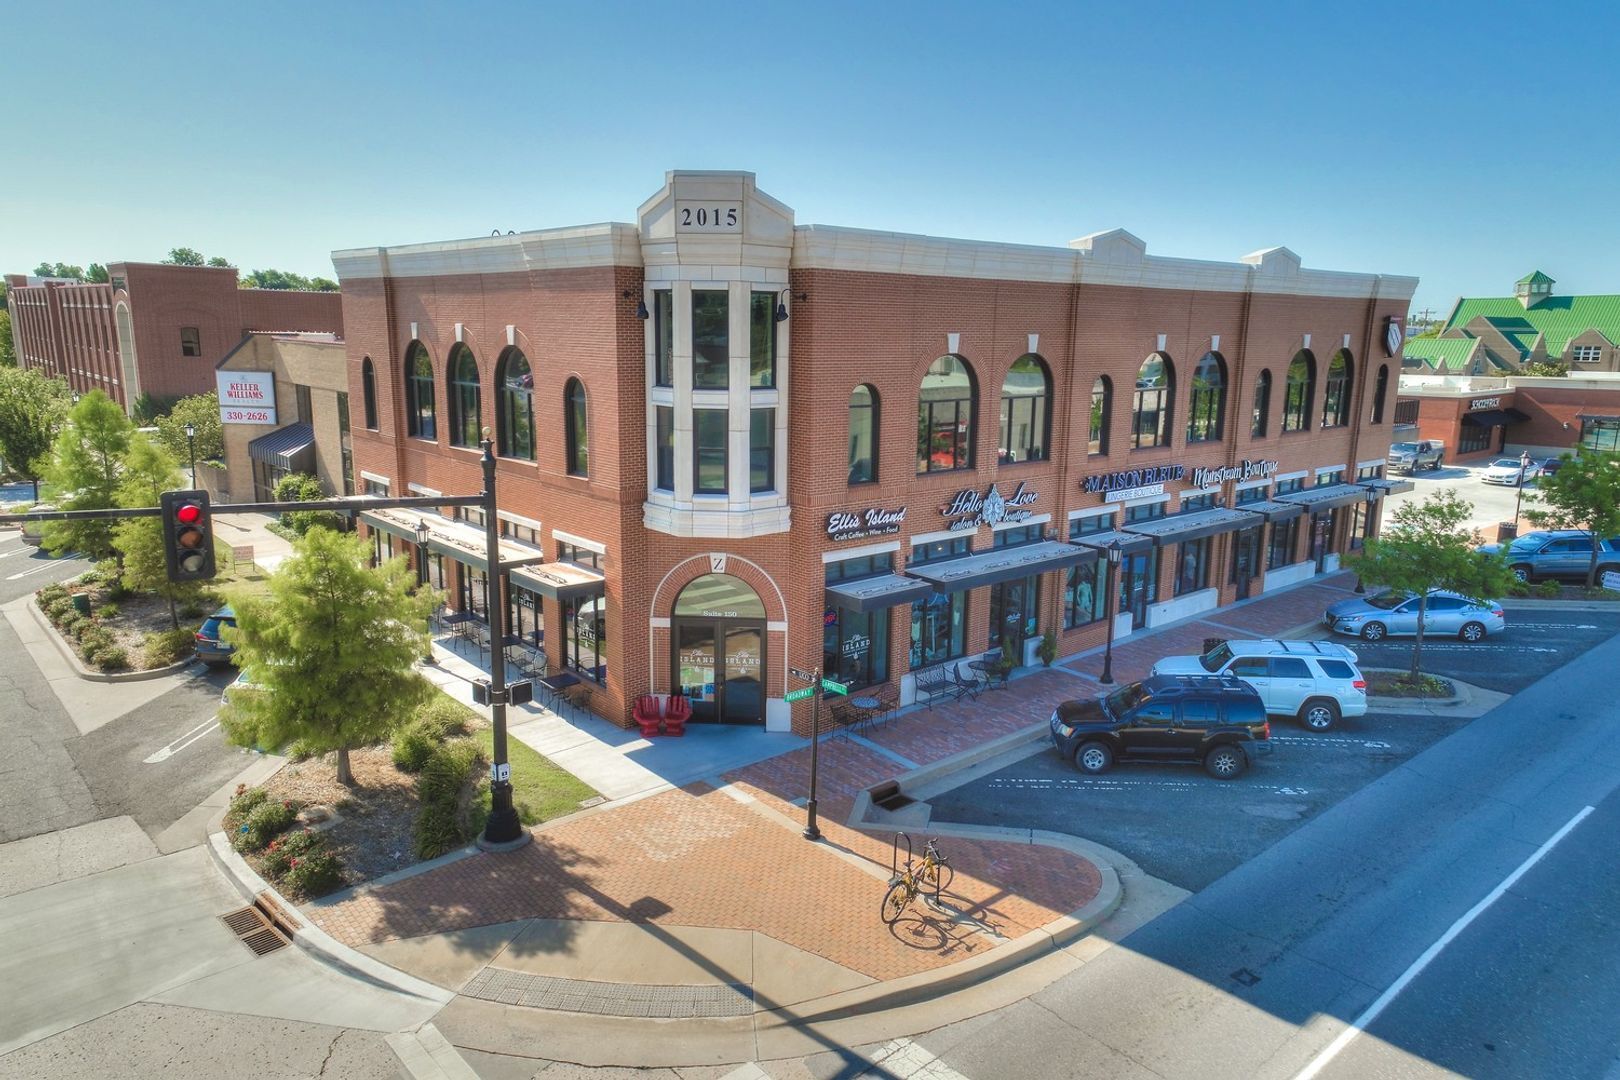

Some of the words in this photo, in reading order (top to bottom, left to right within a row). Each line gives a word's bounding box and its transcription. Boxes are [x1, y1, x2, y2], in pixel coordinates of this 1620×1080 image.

[681, 208, 737, 226] 2015
[230, 383, 259, 391] KELLER
[227, 390, 264, 399] WILLIAMS
[226, 411, 268, 421] 330-2626
[1241, 460, 1278, 484] Boutique
[1085, 471, 1143, 494] MAISON
[1143, 464, 1185, 486] BLEUE
[943, 489, 984, 516] Hello
[1004, 481, 1040, 507] Love
[827, 513, 861, 534] Ellis
[865, 507, 907, 526] Island
[714, 558, 724, 570] Z
[842, 639, 871, 652] ISLAND
[725, 657, 760, 665] ISLAND
